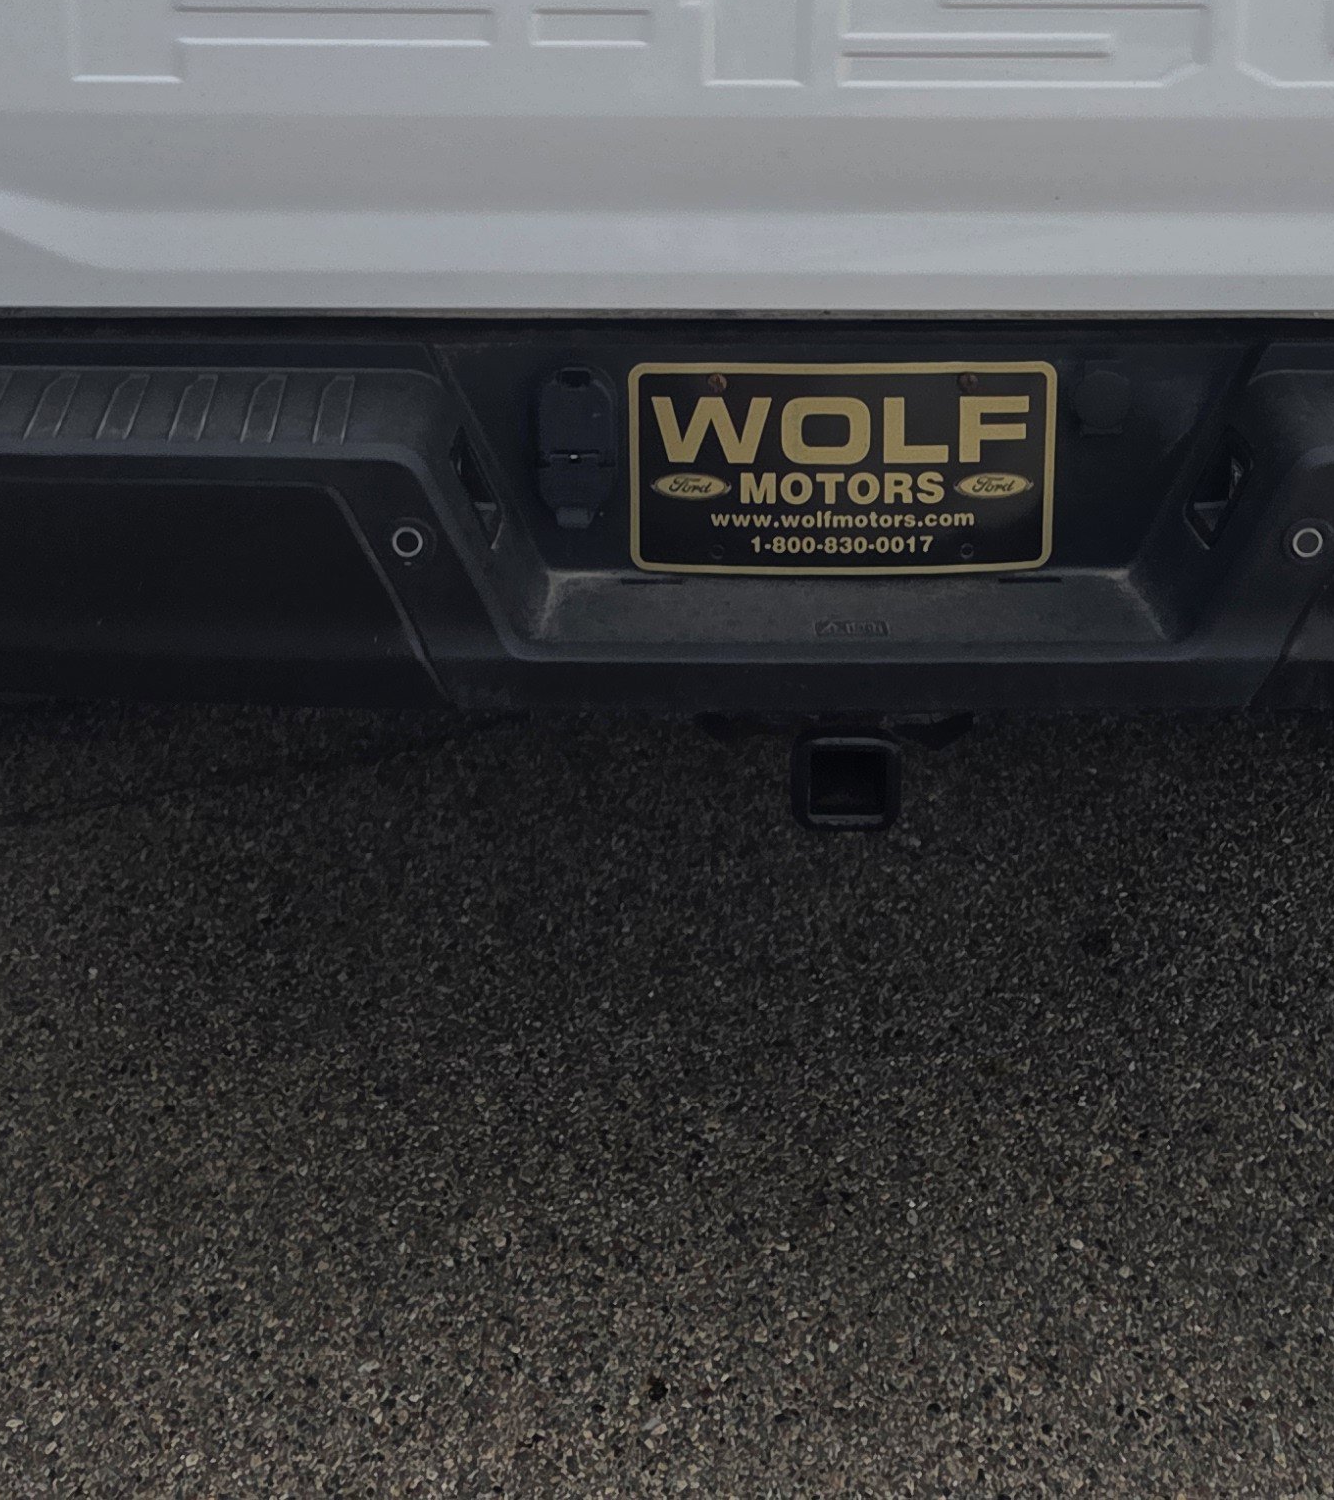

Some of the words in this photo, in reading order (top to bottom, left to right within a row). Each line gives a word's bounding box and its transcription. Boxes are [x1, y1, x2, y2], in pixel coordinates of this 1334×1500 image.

[651, 395, 1030, 464] WOLF
[667, 476, 714, 496] Ford
[739, 471, 946, 505] MOTORS
[970, 476, 1017, 495] Ford
[710, 509, 976, 529] www.wolfmotors.com
[750, 535, 935, 555] 1-800-830-0017
